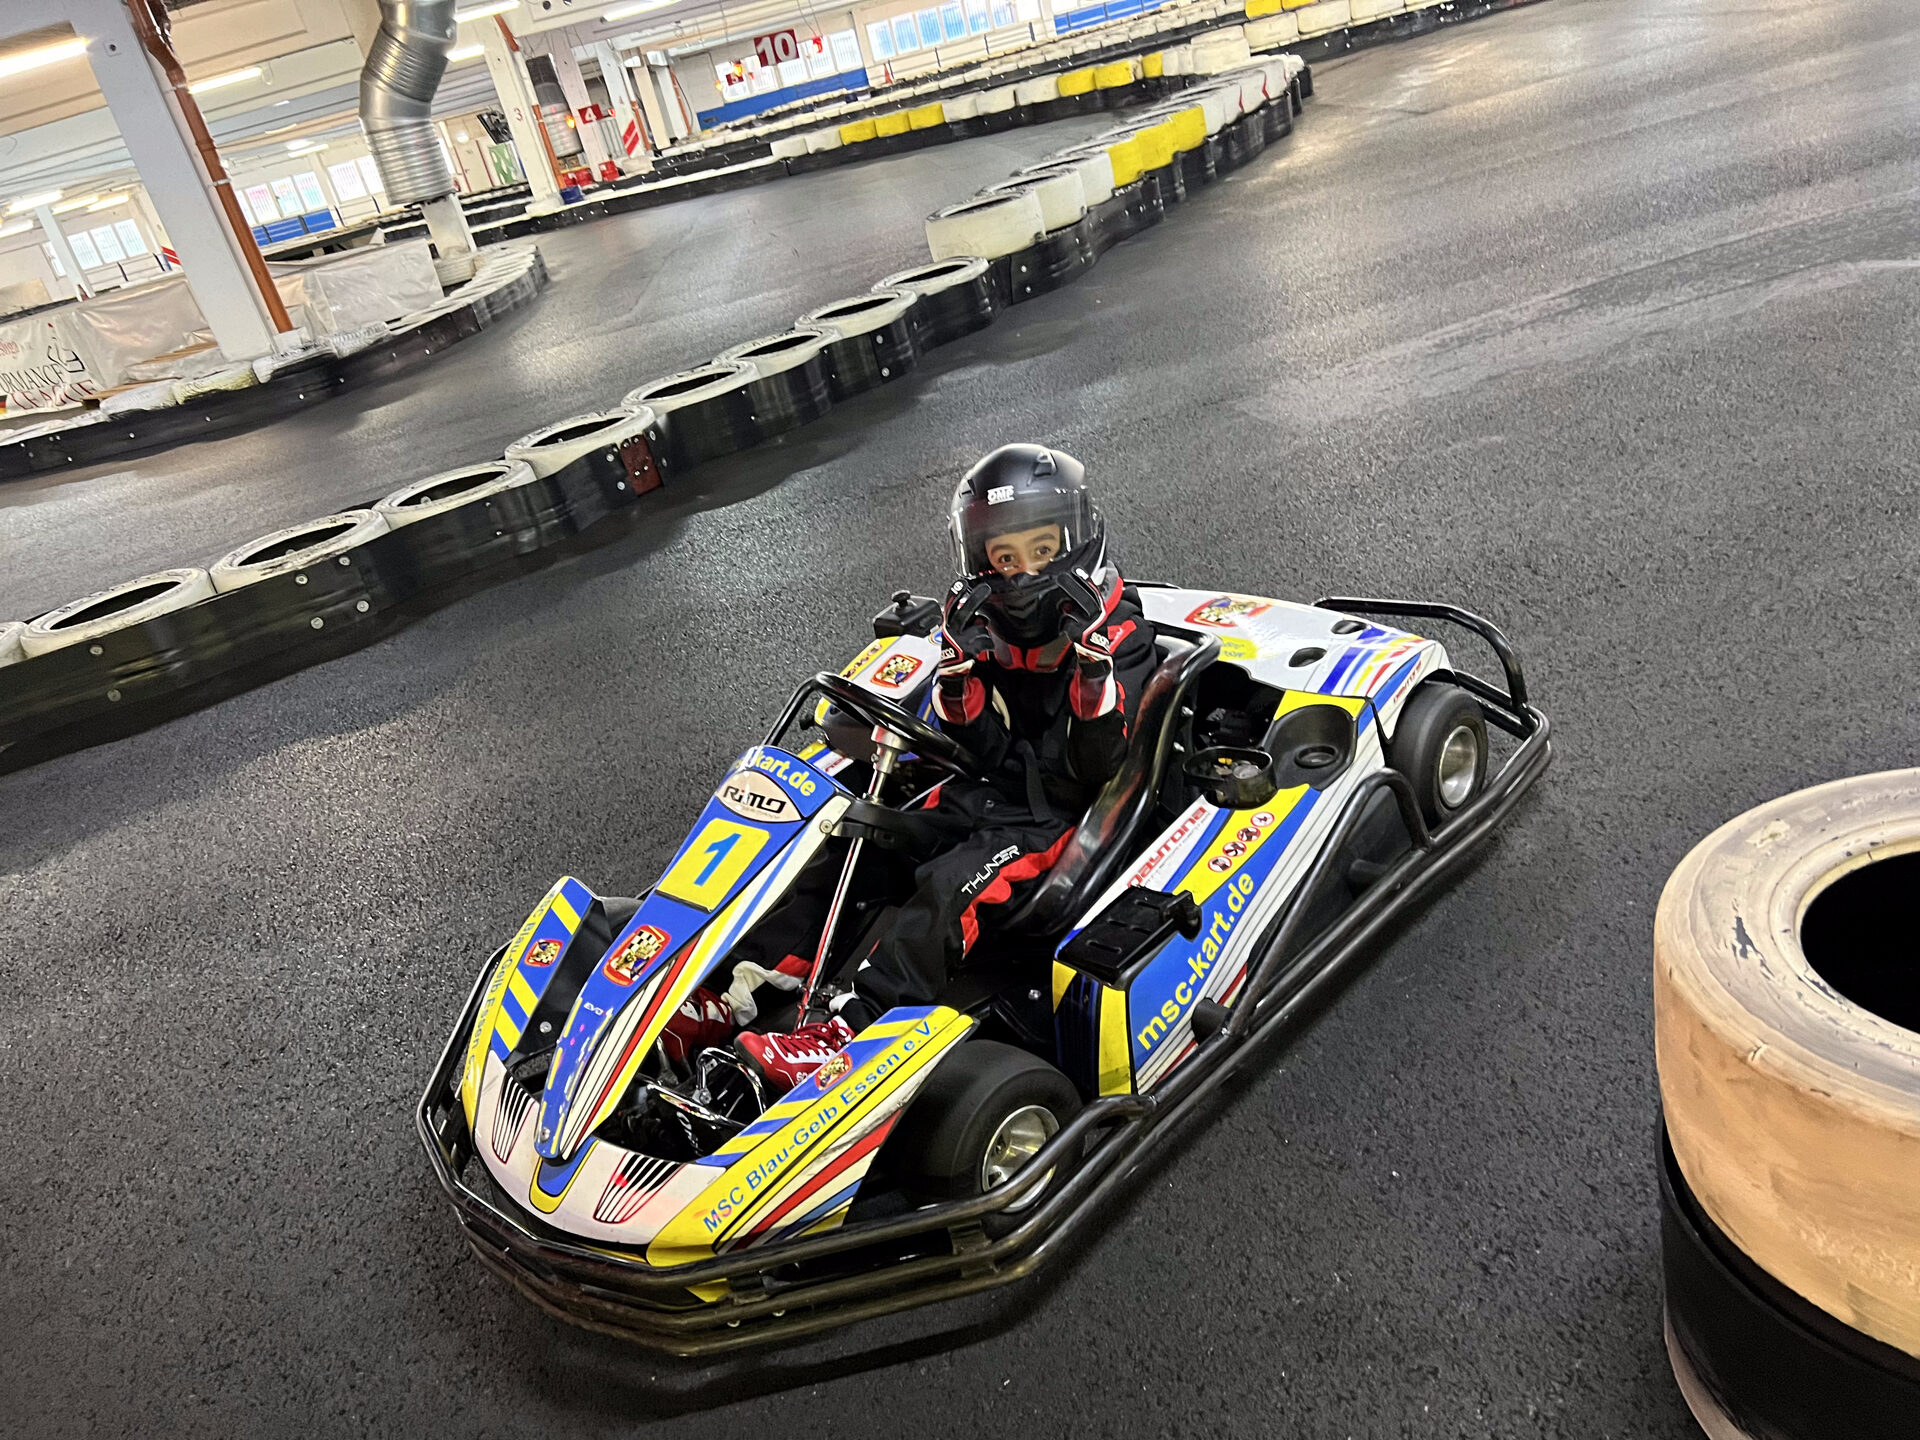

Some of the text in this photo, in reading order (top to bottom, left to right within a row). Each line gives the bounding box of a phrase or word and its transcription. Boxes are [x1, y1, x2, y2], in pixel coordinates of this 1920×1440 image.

[756, 32, 796, 66] 10
[513, 107, 523, 122] 3
[584, 107, 597, 122] 4
[987, 486, 1015, 503] OMP
[693, 832, 742, 888] 1
[961, 844, 1020, 894] THUNDER
[1137, 873, 1254, 1051] msc-kart.de
[702, 1186, 745, 1234] MSC
[746, 1106, 838, 1191] Blau-Gelb
[839, 1053, 901, 1106] Essen
